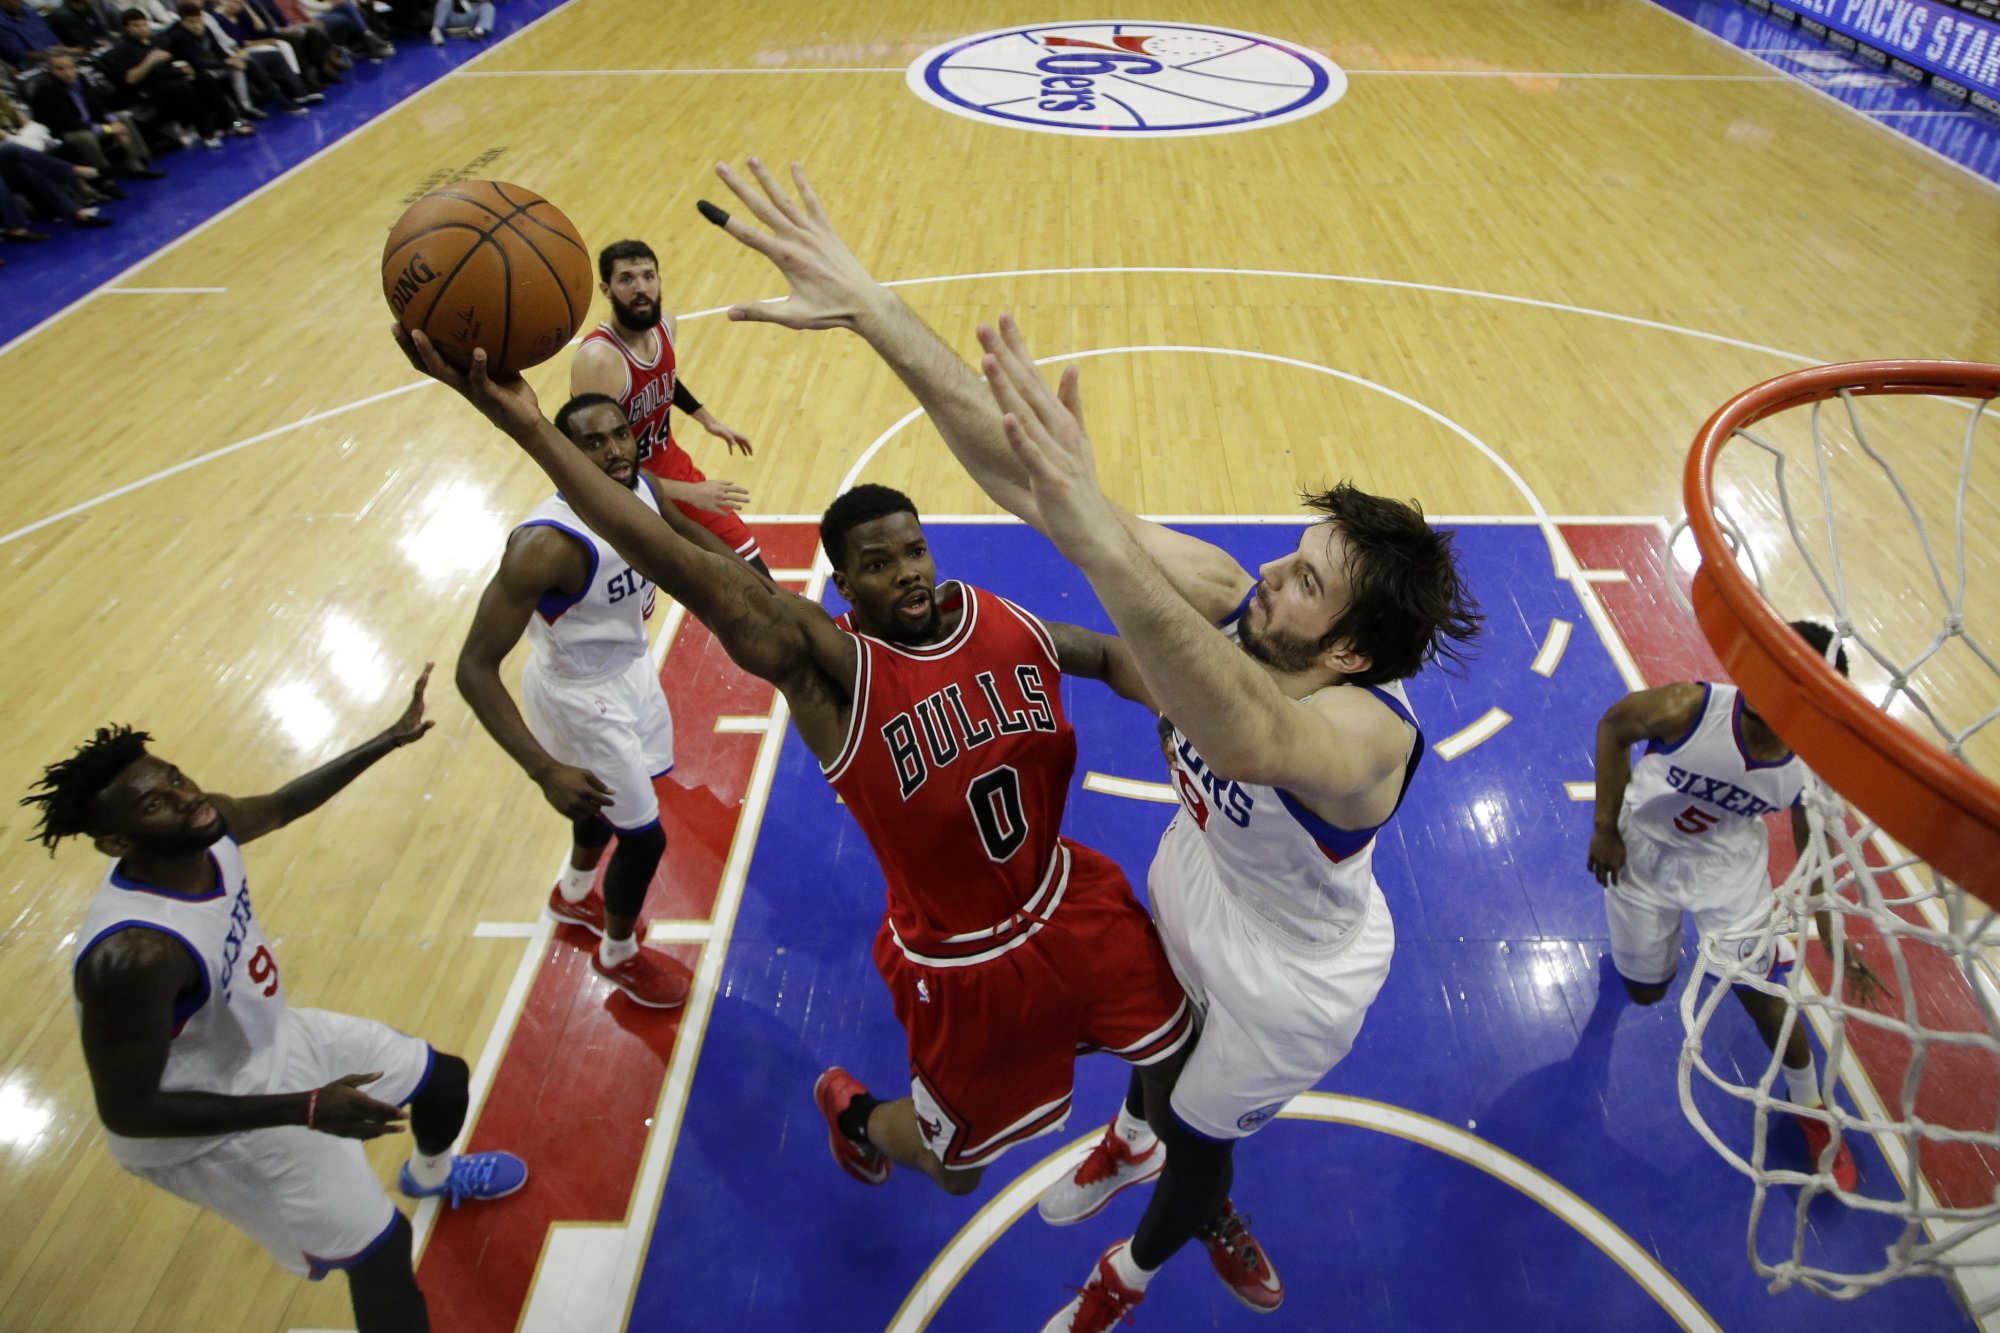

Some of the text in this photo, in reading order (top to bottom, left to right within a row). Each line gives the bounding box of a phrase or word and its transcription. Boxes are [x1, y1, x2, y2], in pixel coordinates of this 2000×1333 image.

[1841, 0, 1928, 52] PACKS
[881, 664, 1057, 802] BULLS
[965, 763, 1029, 864] 0
[1673, 805, 1721, 834] 5
[247, 944, 279, 998] 9
